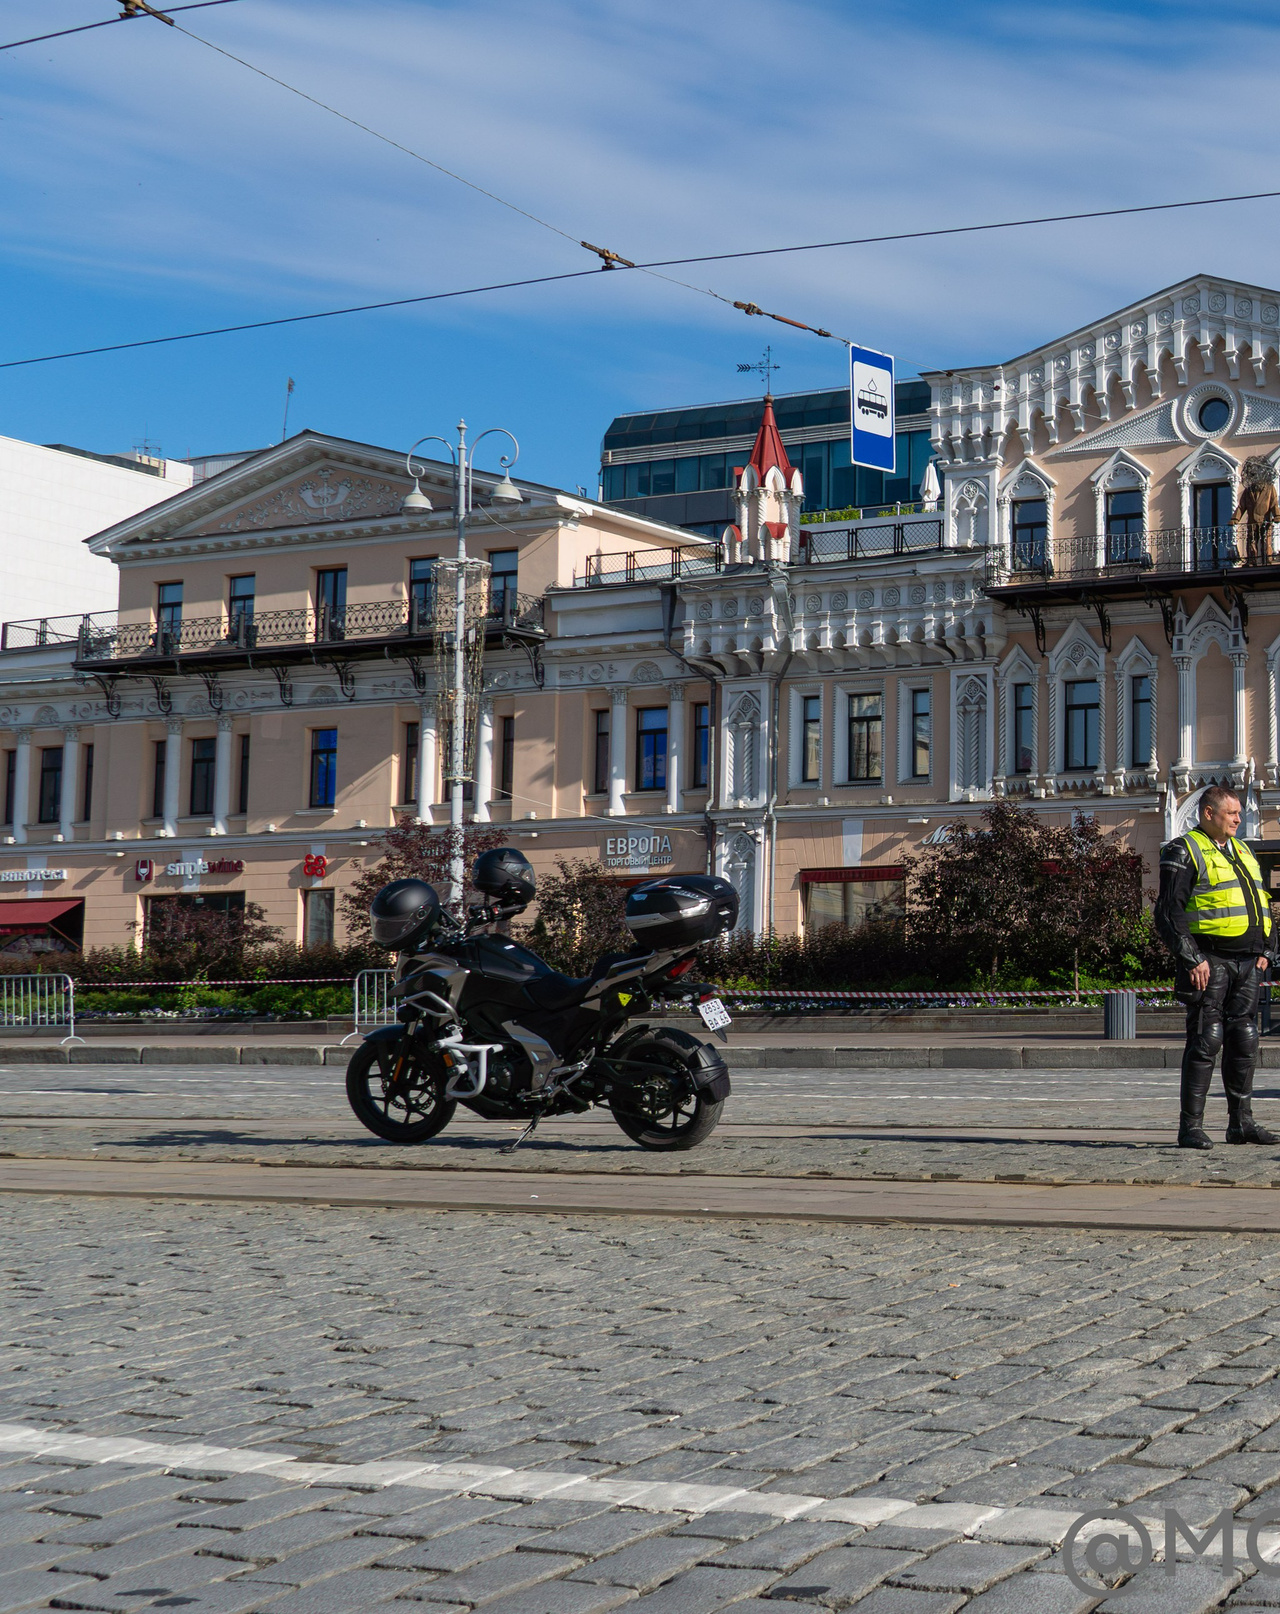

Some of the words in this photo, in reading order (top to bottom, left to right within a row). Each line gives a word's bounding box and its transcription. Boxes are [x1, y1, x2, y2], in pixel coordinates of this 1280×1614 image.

[606, 836, 672, 855] ЕВРОПА
[607, 855, 647, 867] ТОРГОВЫЙ
[649, 855, 672, 866] ЦЕНТР
[702, 1000, 721, 1015] 2853
